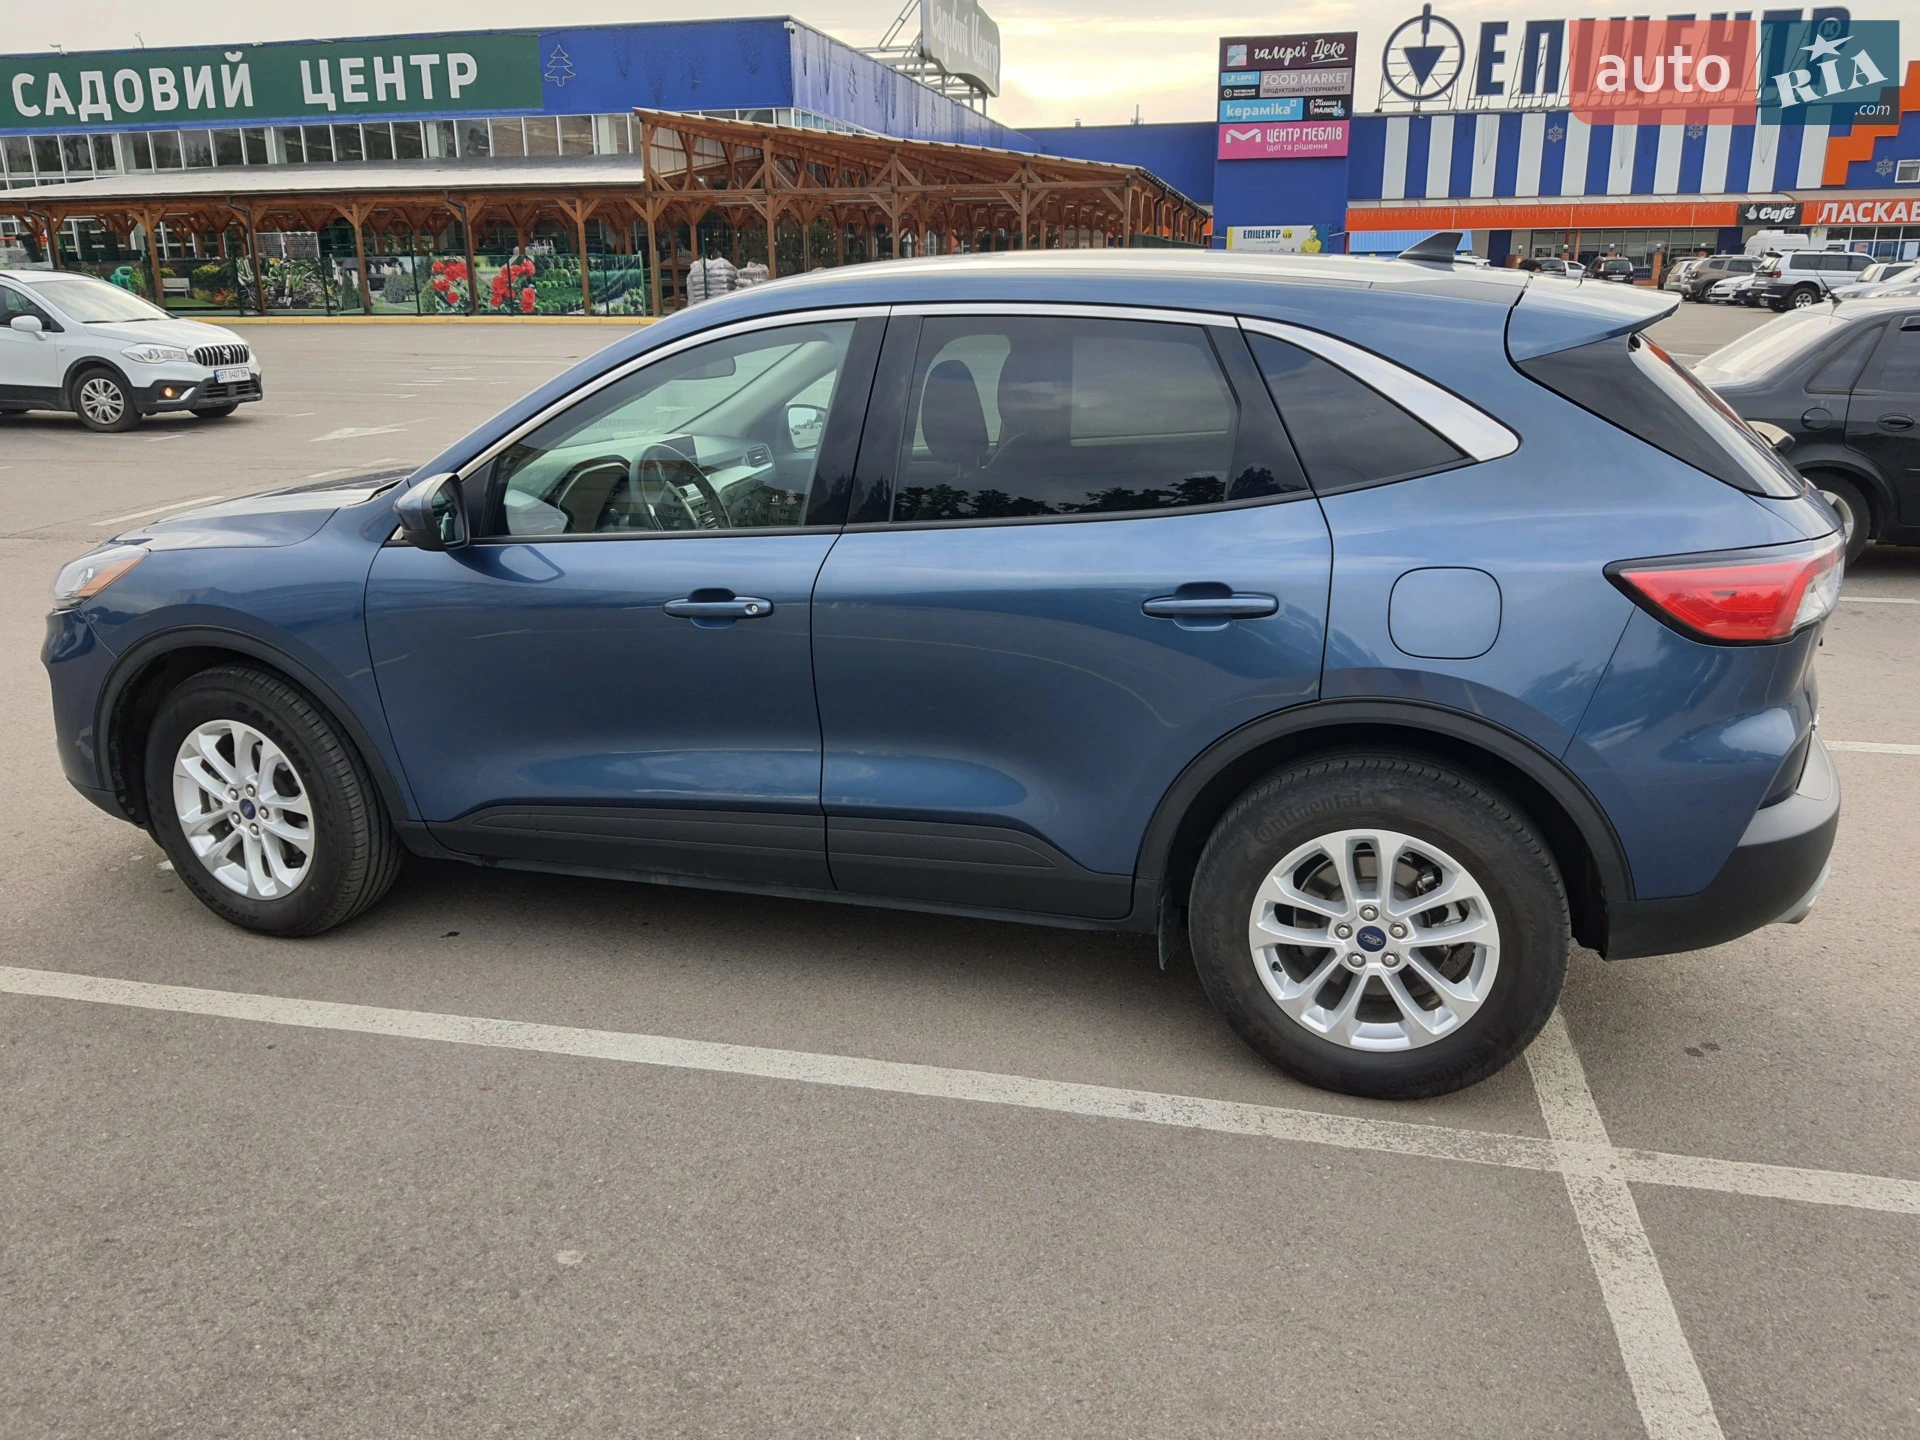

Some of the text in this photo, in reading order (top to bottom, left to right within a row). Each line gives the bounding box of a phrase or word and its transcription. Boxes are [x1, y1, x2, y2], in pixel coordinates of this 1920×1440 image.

[971, 11, 998, 89] Центр
[1253, 39, 1347, 66] галереї Деко
[11, 51, 478, 121] САДОВИЙ ЦЕНТР
[1263, 72, 1348, 86] FOOD MARKET
[1304, 85, 1345, 93] СУПЕРМАРКЕТ
[1226, 103, 1291, 119] кераміка
[1266, 126, 1343, 142] ЦЕНТР МЕБЛІВ
[1266, 143, 1282, 152] ідеї
[1294, 143, 1328, 152] рішення
[1243, 229, 1281, 239] ЕПІЦЕНТР
